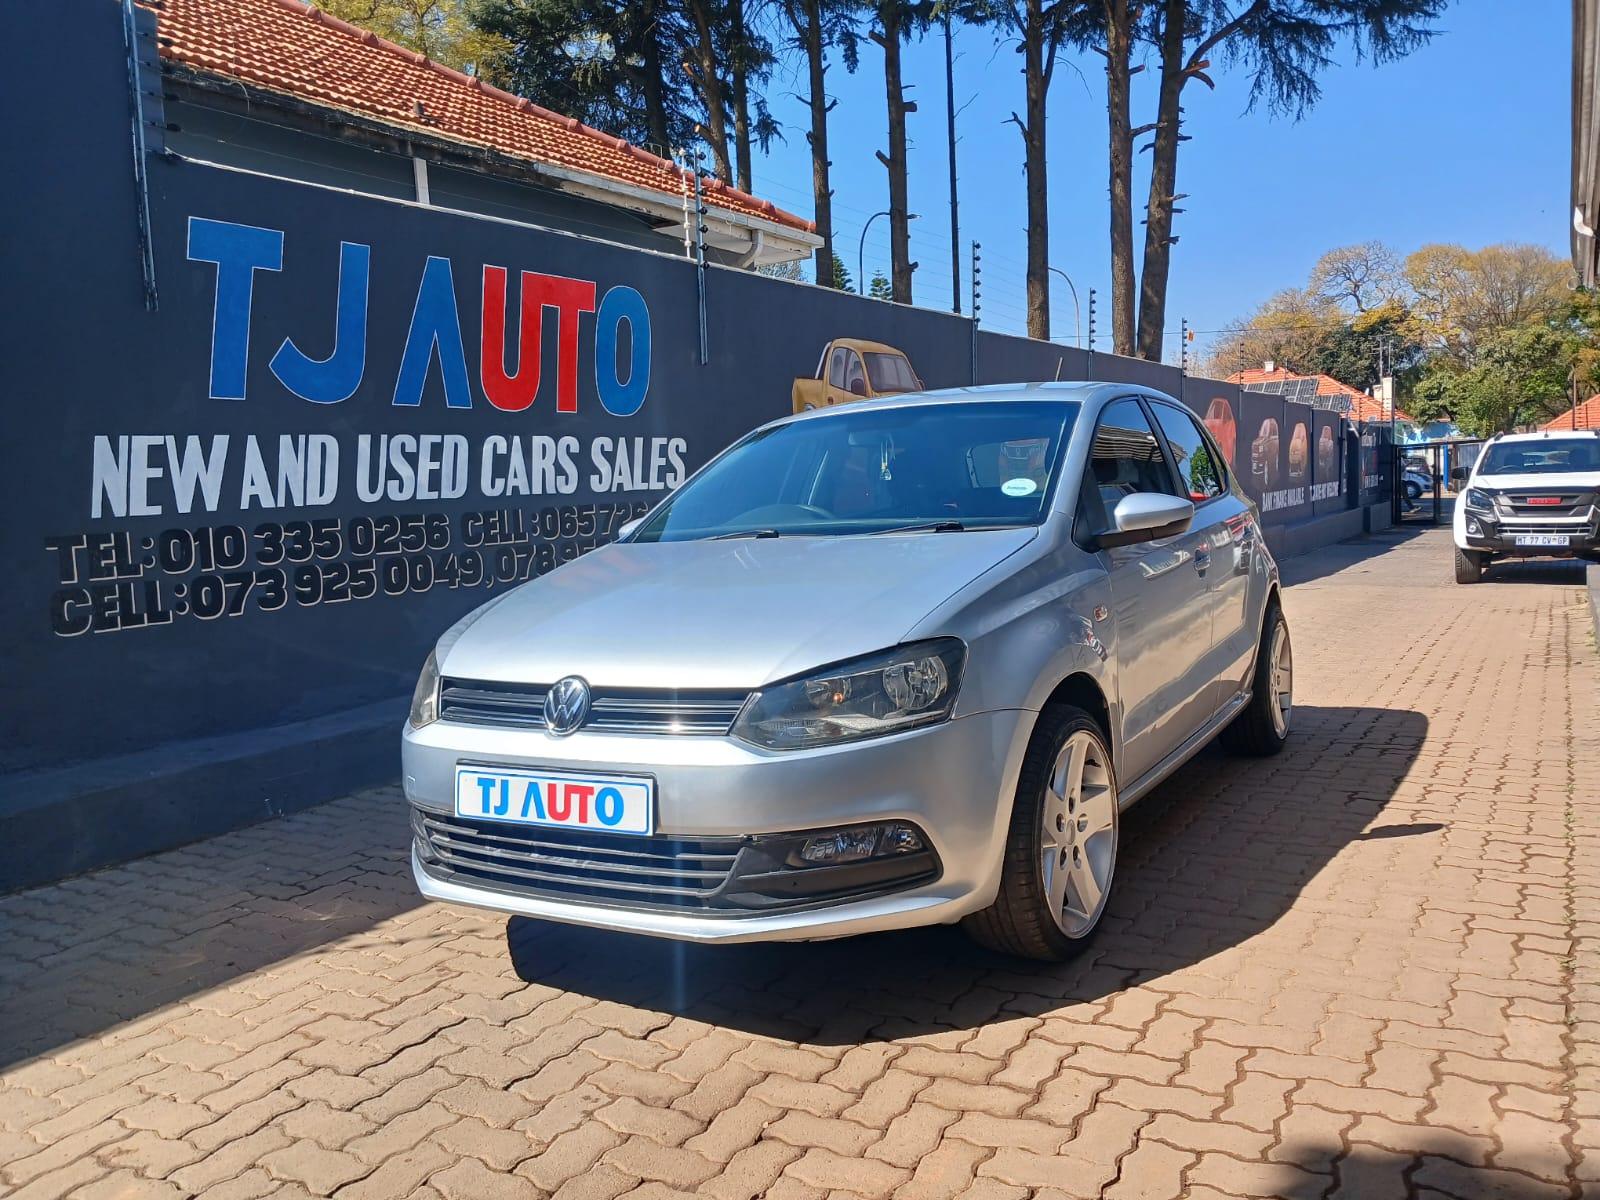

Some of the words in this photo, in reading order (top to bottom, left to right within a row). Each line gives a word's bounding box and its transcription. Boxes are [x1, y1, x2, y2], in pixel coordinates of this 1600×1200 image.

[187, 216, 371, 405] TJ
[391, 255, 652, 417] AUTO
[91, 434, 230, 519] NEW
[240, 434, 340, 510] AND
[356, 434, 469, 503] USED
[480, 435, 580, 496] CARS
[590, 436, 688, 493] SALES
[253, 518, 343, 566] 335
[349, 513, 451, 557] 0256
[294, 559, 378, 608] 925
[477, 777, 509, 816] TJ
[520, 781, 625, 826] AUTO
